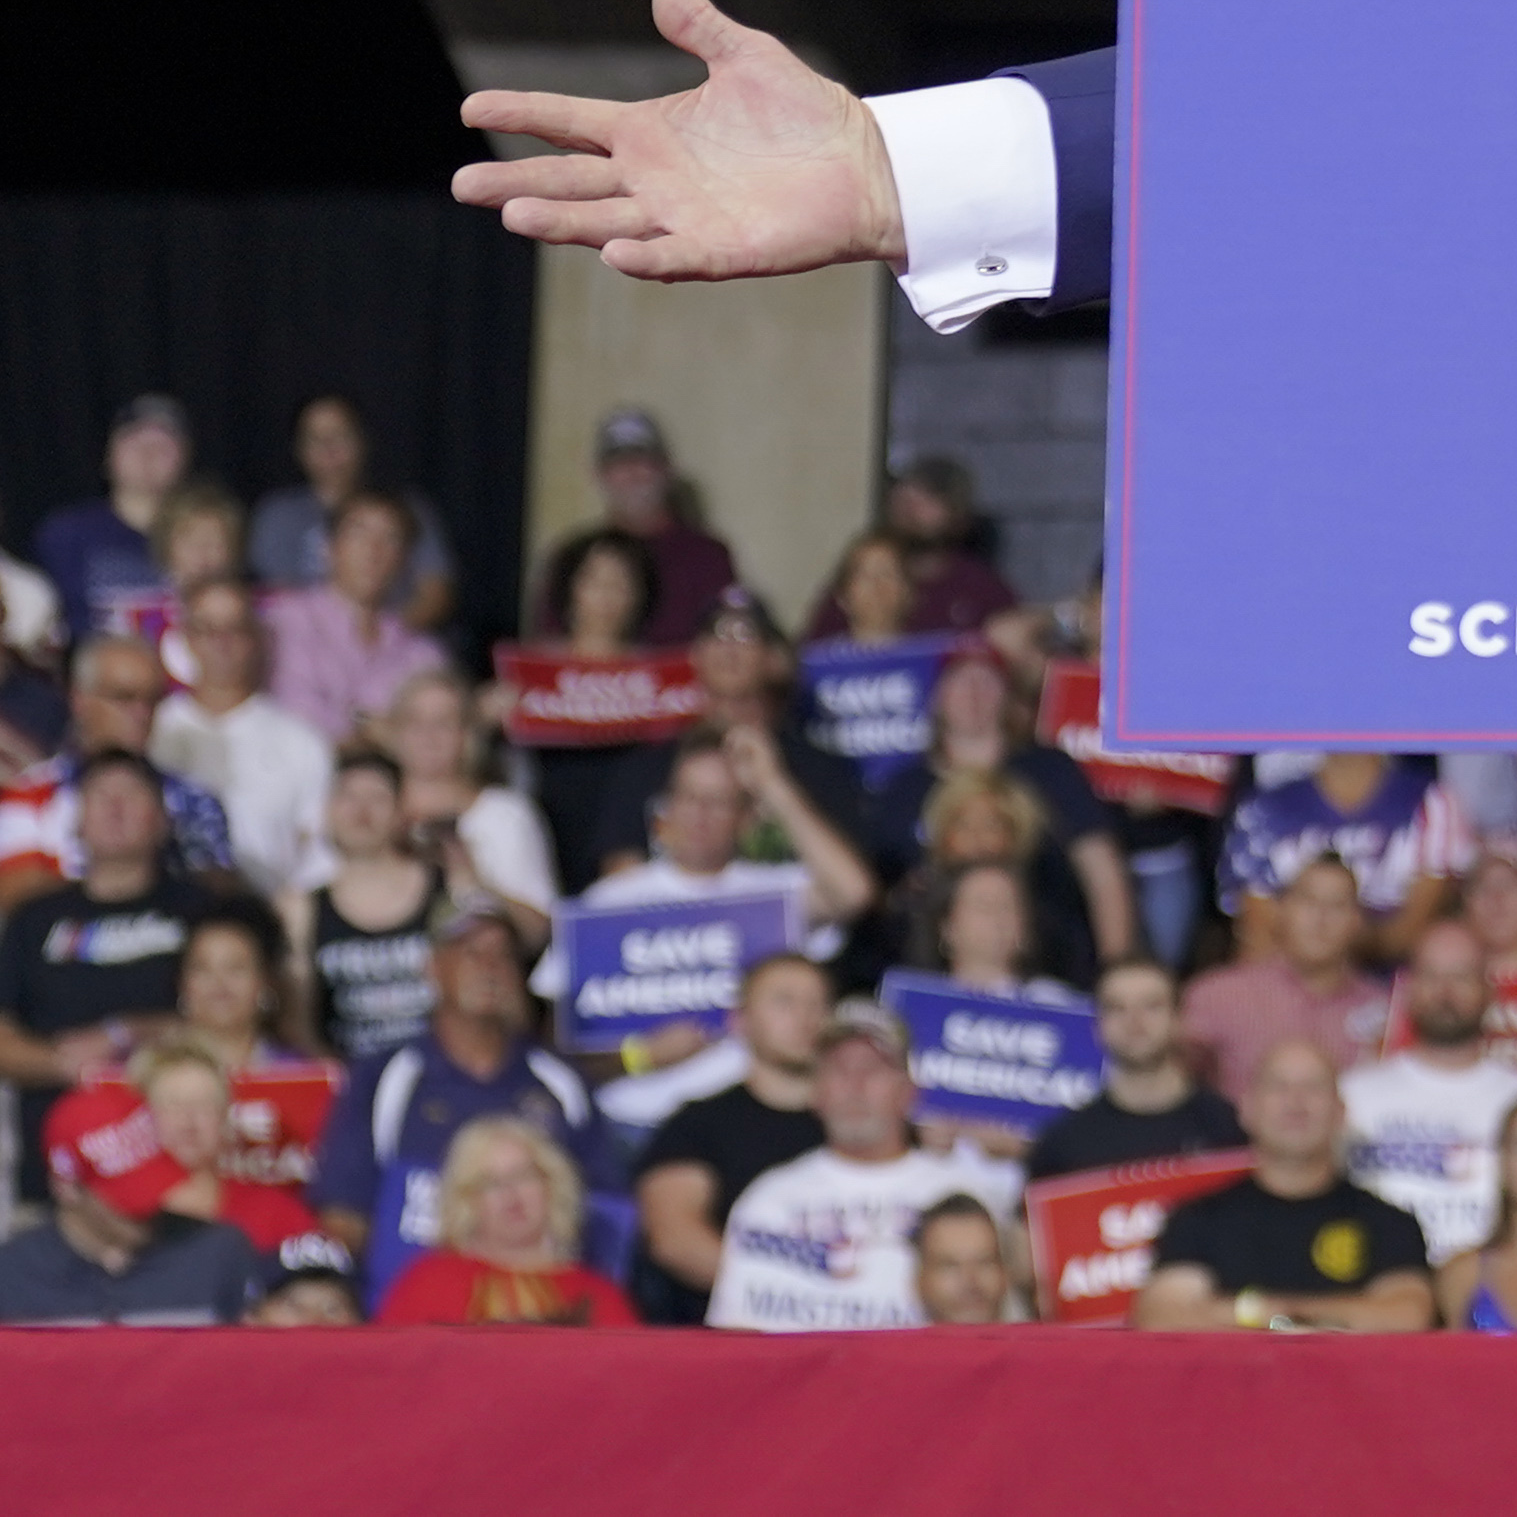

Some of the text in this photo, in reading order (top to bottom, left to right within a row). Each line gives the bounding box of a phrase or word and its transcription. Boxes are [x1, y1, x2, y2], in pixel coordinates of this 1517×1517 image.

[620, 920, 740, 974] SAVE
[575, 969, 744, 1018] AMERIC
[942, 1008, 1062, 1068] SAVE
[1098, 1198, 1168, 1250] SA
